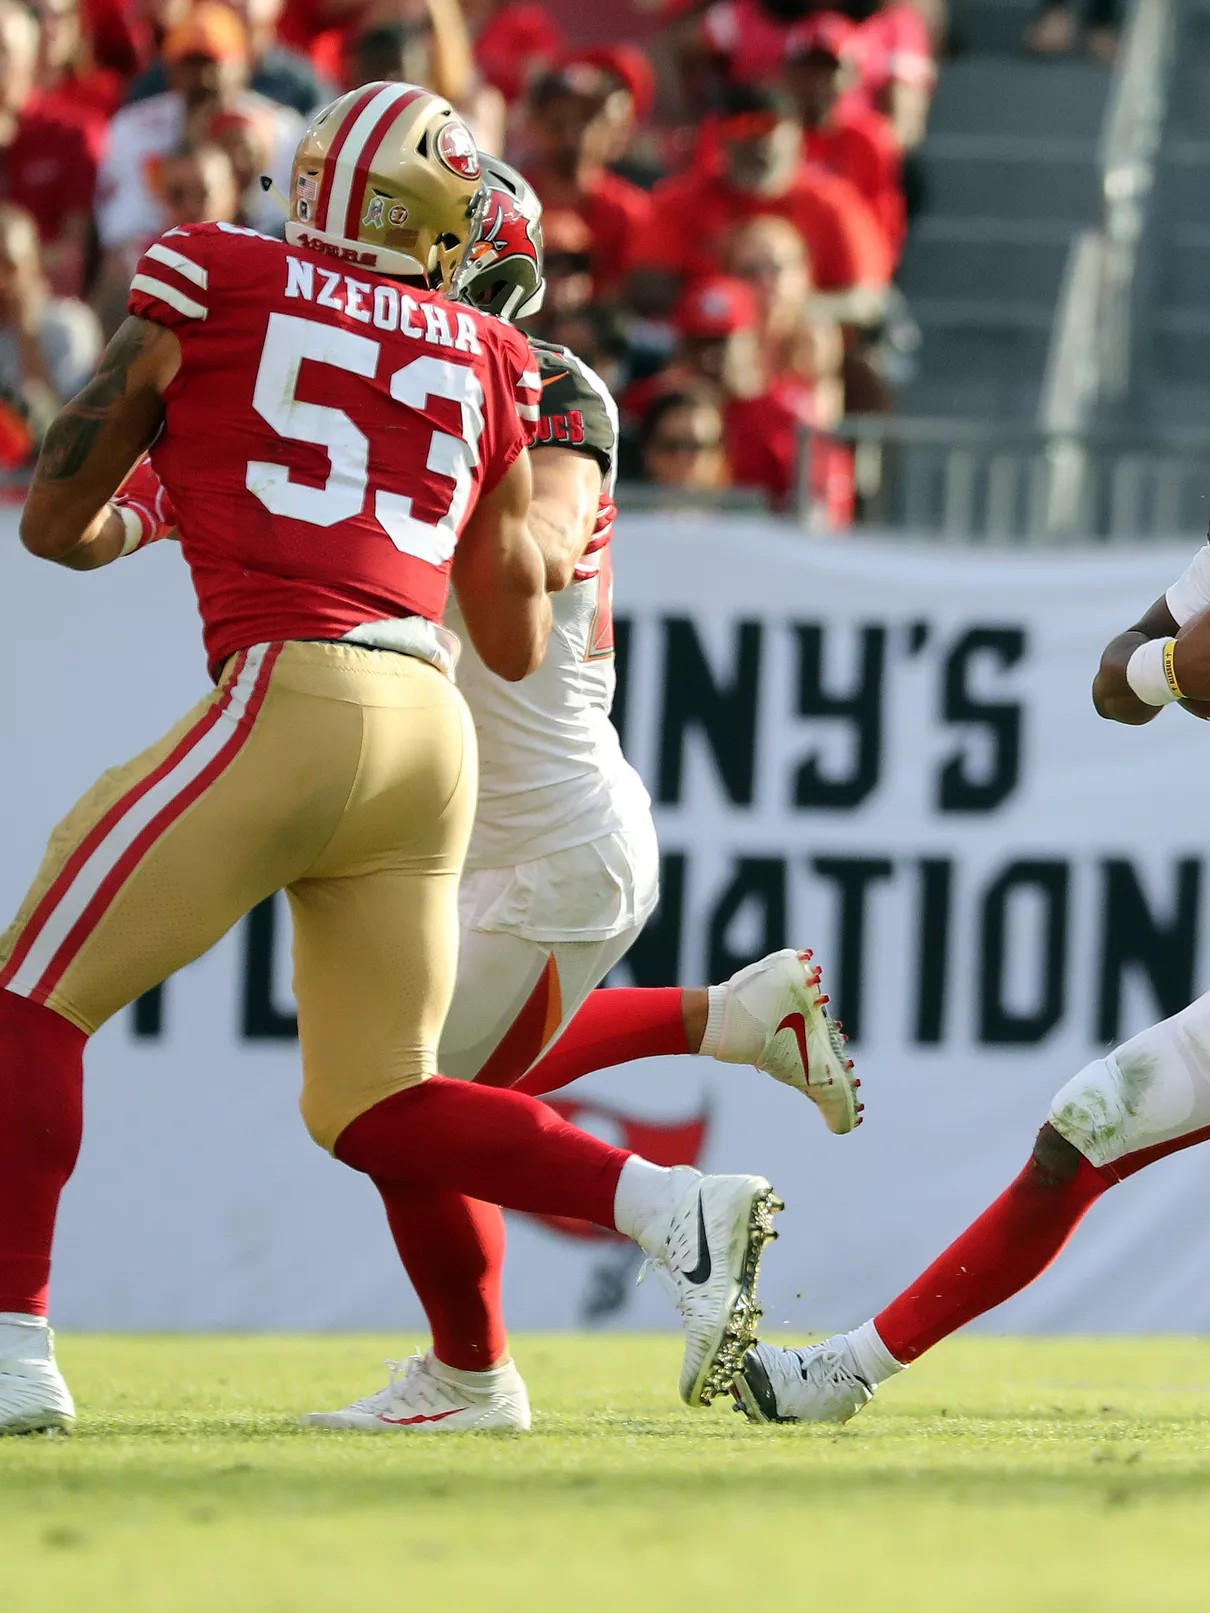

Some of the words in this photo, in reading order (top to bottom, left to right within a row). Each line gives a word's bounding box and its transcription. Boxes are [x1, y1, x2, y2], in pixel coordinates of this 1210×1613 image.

[284, 255, 482, 356] NZEOCHA
[245, 311, 485, 567] 53
[536, 409, 585, 445] UCS
